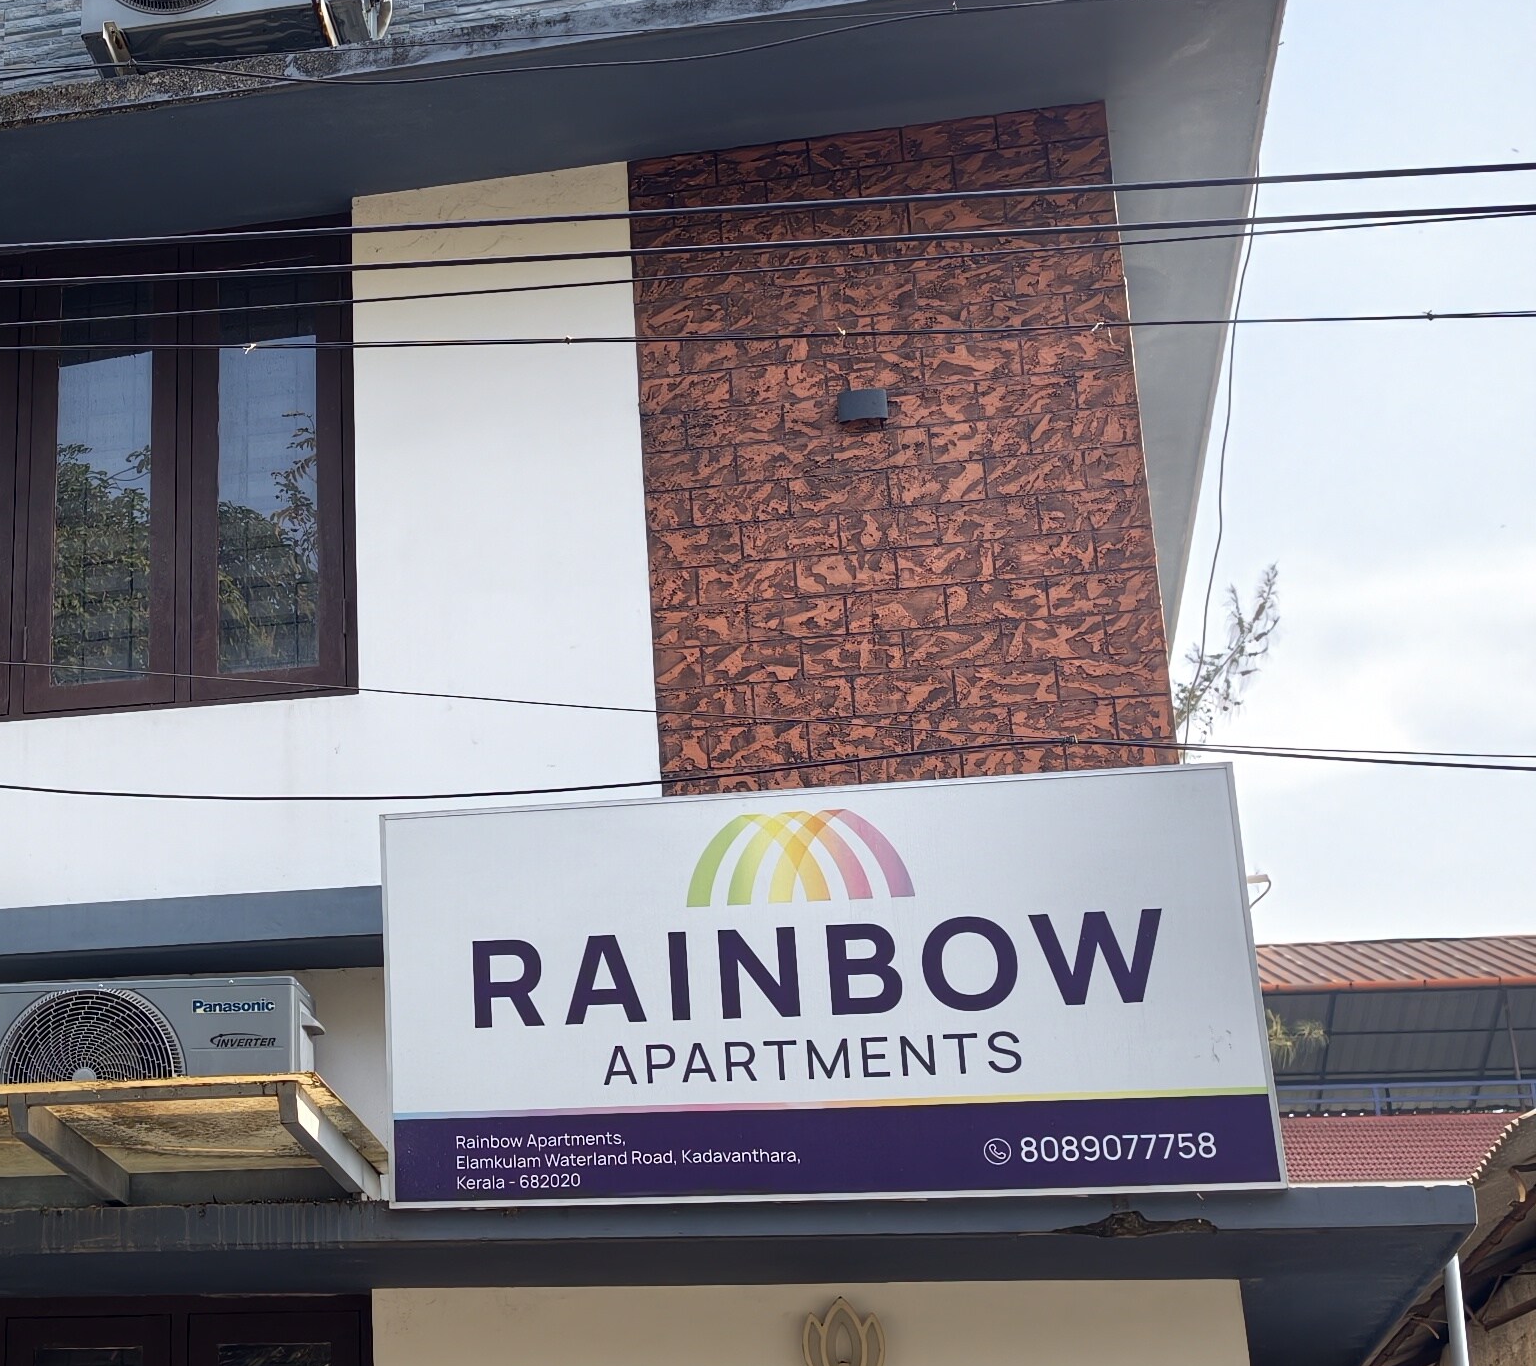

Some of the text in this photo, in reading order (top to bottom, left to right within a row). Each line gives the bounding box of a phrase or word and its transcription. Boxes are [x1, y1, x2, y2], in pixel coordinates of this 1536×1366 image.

[473, 909, 1162, 1028] RAINBOW
[192, 998, 275, 1013] Panasonic
[604, 1031, 1021, 1085] APARTMENTS
[455, 1131, 626, 1152] Rainbow Apartments,
[1020, 1132, 1217, 1163] 8089077758
[455, 1147, 802, 1170] Elamkulam Waterland Road, Kadavanthara,
[456, 1174, 505, 1190] Kerala
[519, 1172, 582, 1189] 682020
